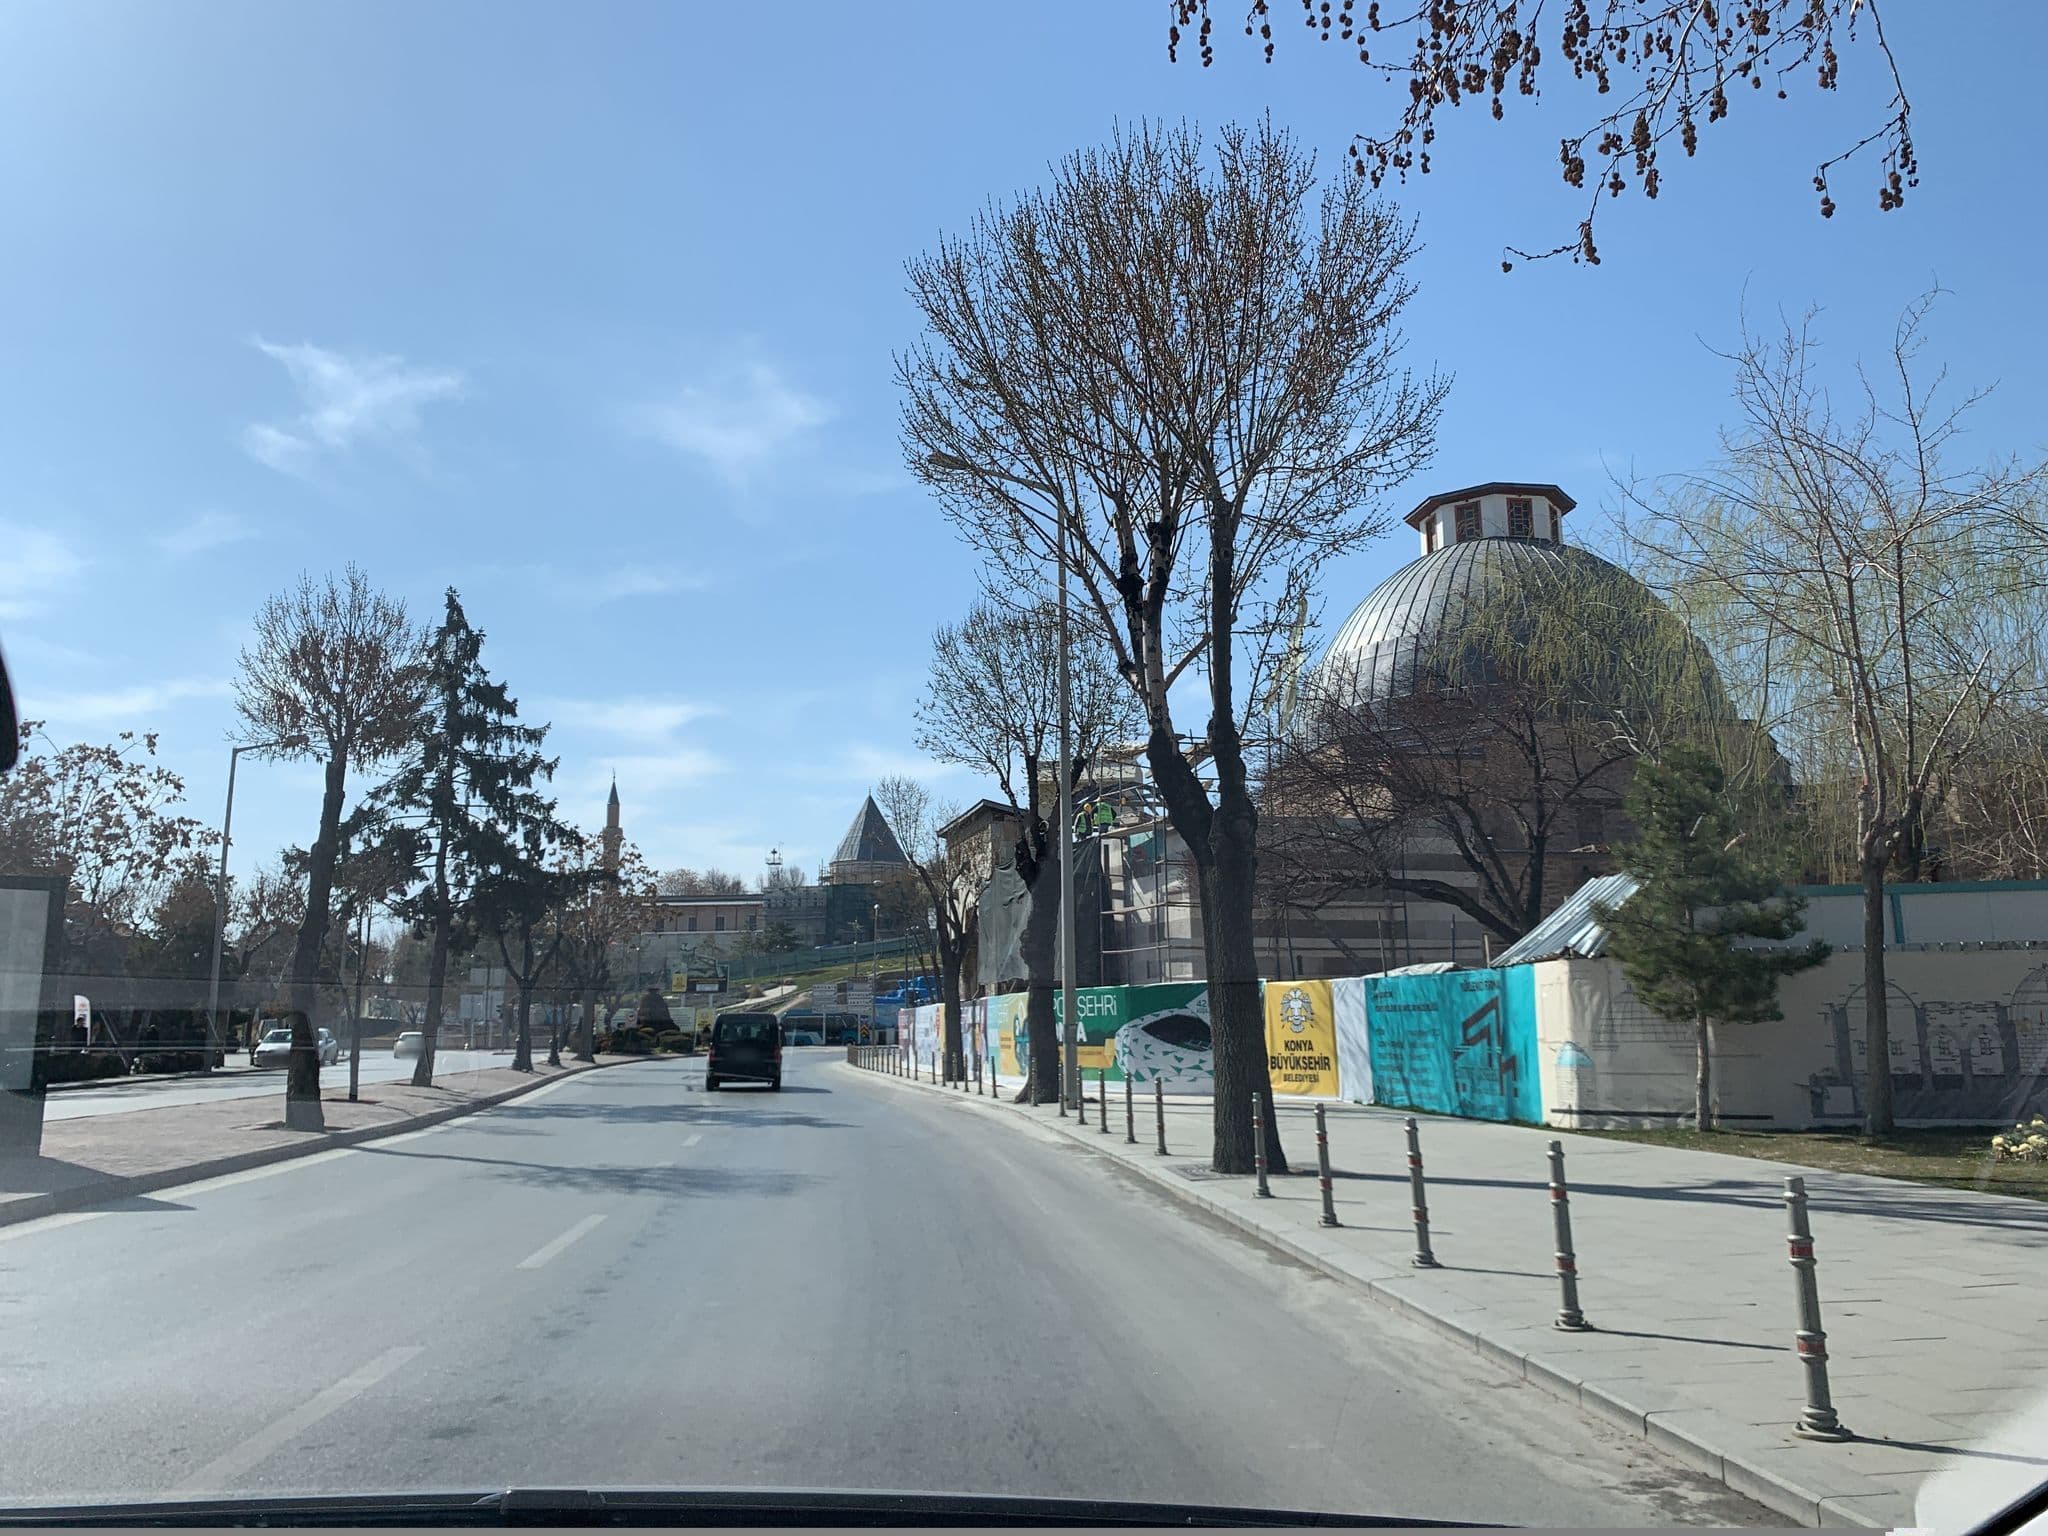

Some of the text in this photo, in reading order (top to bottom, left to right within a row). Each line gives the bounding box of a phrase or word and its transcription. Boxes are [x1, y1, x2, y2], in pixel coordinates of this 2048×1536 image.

[1284, 1039, 1314, 1052] KONYA
[1270, 1053, 1331, 1073] BÜYÜKŞEHİR
[1283, 1072, 1320, 1083] BELEDİYESİ
